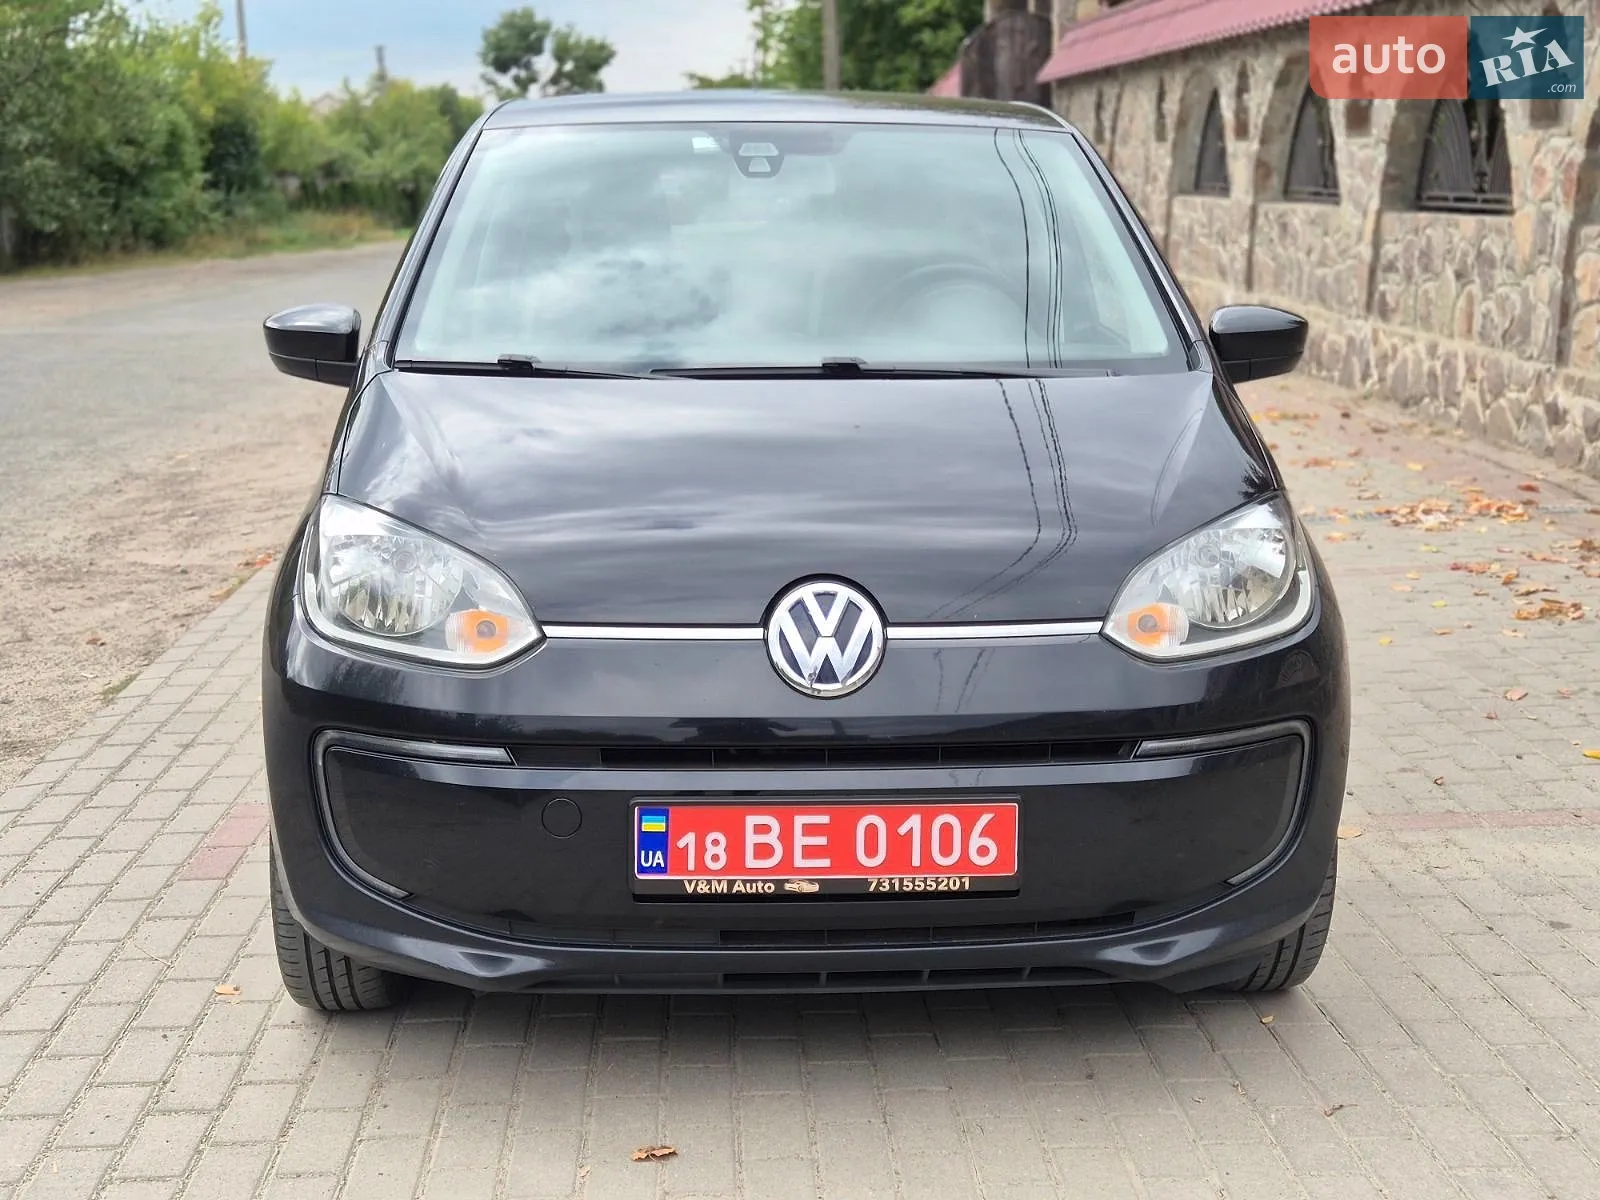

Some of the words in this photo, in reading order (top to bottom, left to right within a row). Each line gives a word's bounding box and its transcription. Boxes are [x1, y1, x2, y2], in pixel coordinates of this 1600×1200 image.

[676, 831, 727, 871] 18
[744, 814, 831, 869] BE
[855, 813, 998, 868] 0106
[640, 850, 665, 868] UA
[683, 880, 728, 895] V&M
[732, 879, 775, 895] Auto
[867, 876, 971, 892] 731555201
